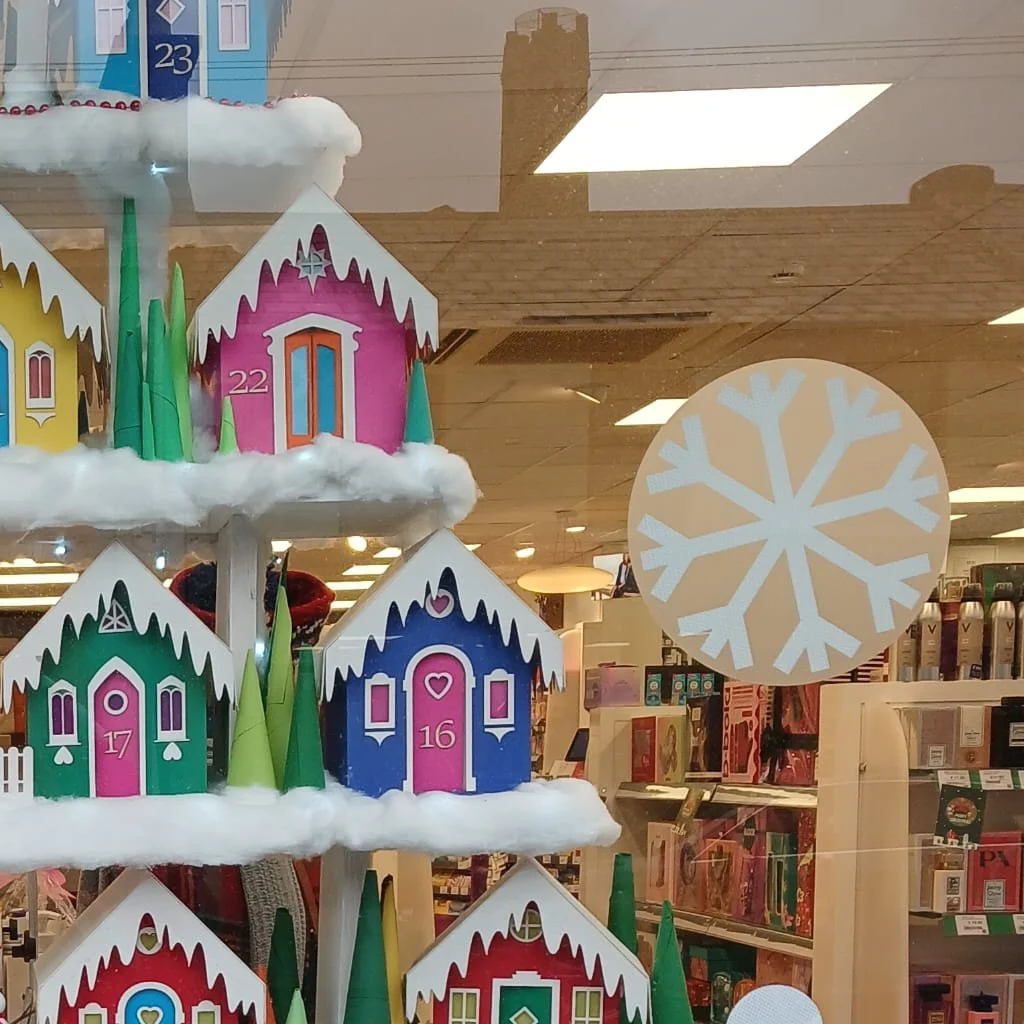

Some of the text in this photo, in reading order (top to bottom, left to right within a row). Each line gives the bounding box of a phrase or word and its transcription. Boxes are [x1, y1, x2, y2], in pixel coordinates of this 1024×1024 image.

[155, 43, 192, 74] 23
[229, 369, 269, 394] 22
[103, 730, 132, 758] 17
[420, 720, 456, 748] 16
